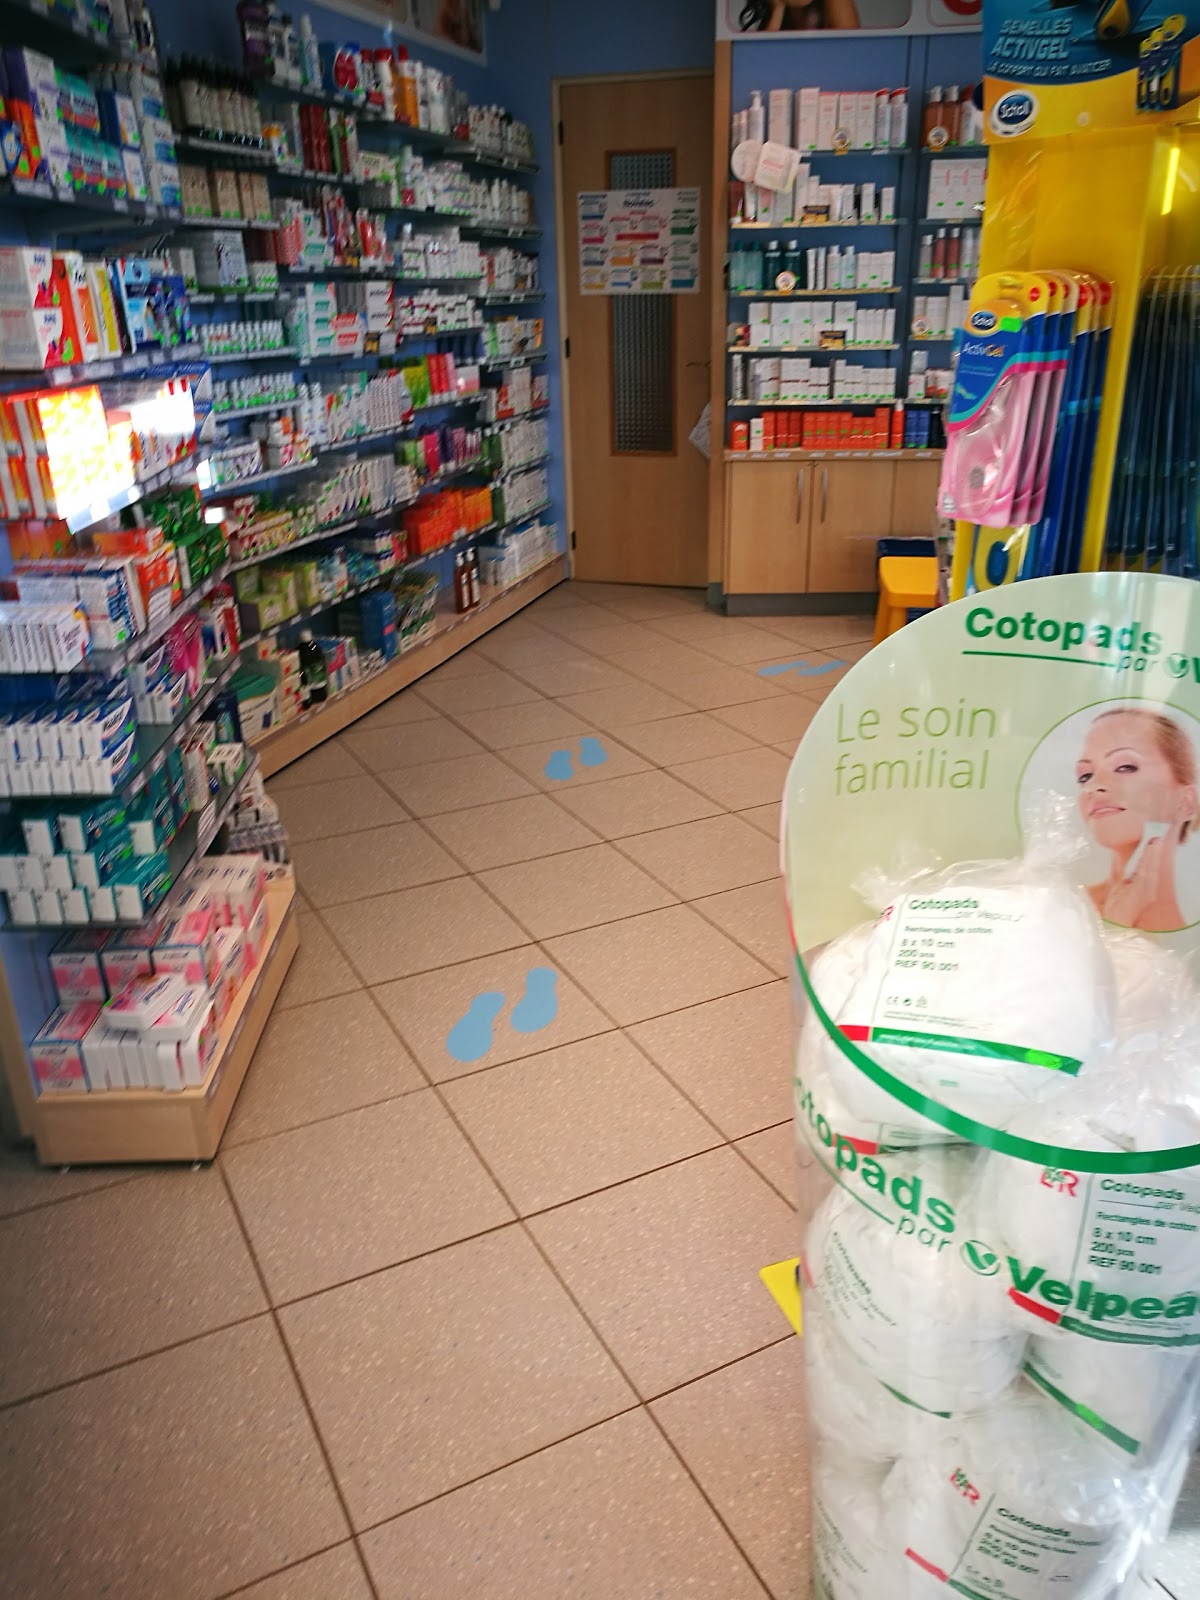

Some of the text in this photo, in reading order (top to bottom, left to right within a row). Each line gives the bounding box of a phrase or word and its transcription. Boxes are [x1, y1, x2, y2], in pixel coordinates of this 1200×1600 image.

[1000, 18, 1073, 36] SEMELLES
[991, 37, 1070, 60] ACTIVGEL
[1000, 101, 1030, 119] Scholl
[965, 607, 1163, 655] Cotopads
[837, 698, 997, 743] Le soin
[835, 748, 990, 796] familial
[909, 898, 979, 911] Cotopads
[1101, 1179, 1185, 1200] Cotopads
[896, 1216, 952, 1252] par
[1090, 1241, 1115, 1254] 200
[1088, 1255, 1118, 1268] REF
[1007, 1256, 1200, 1321] Velpea
[997, 1508, 1071, 1537] Cotopads
